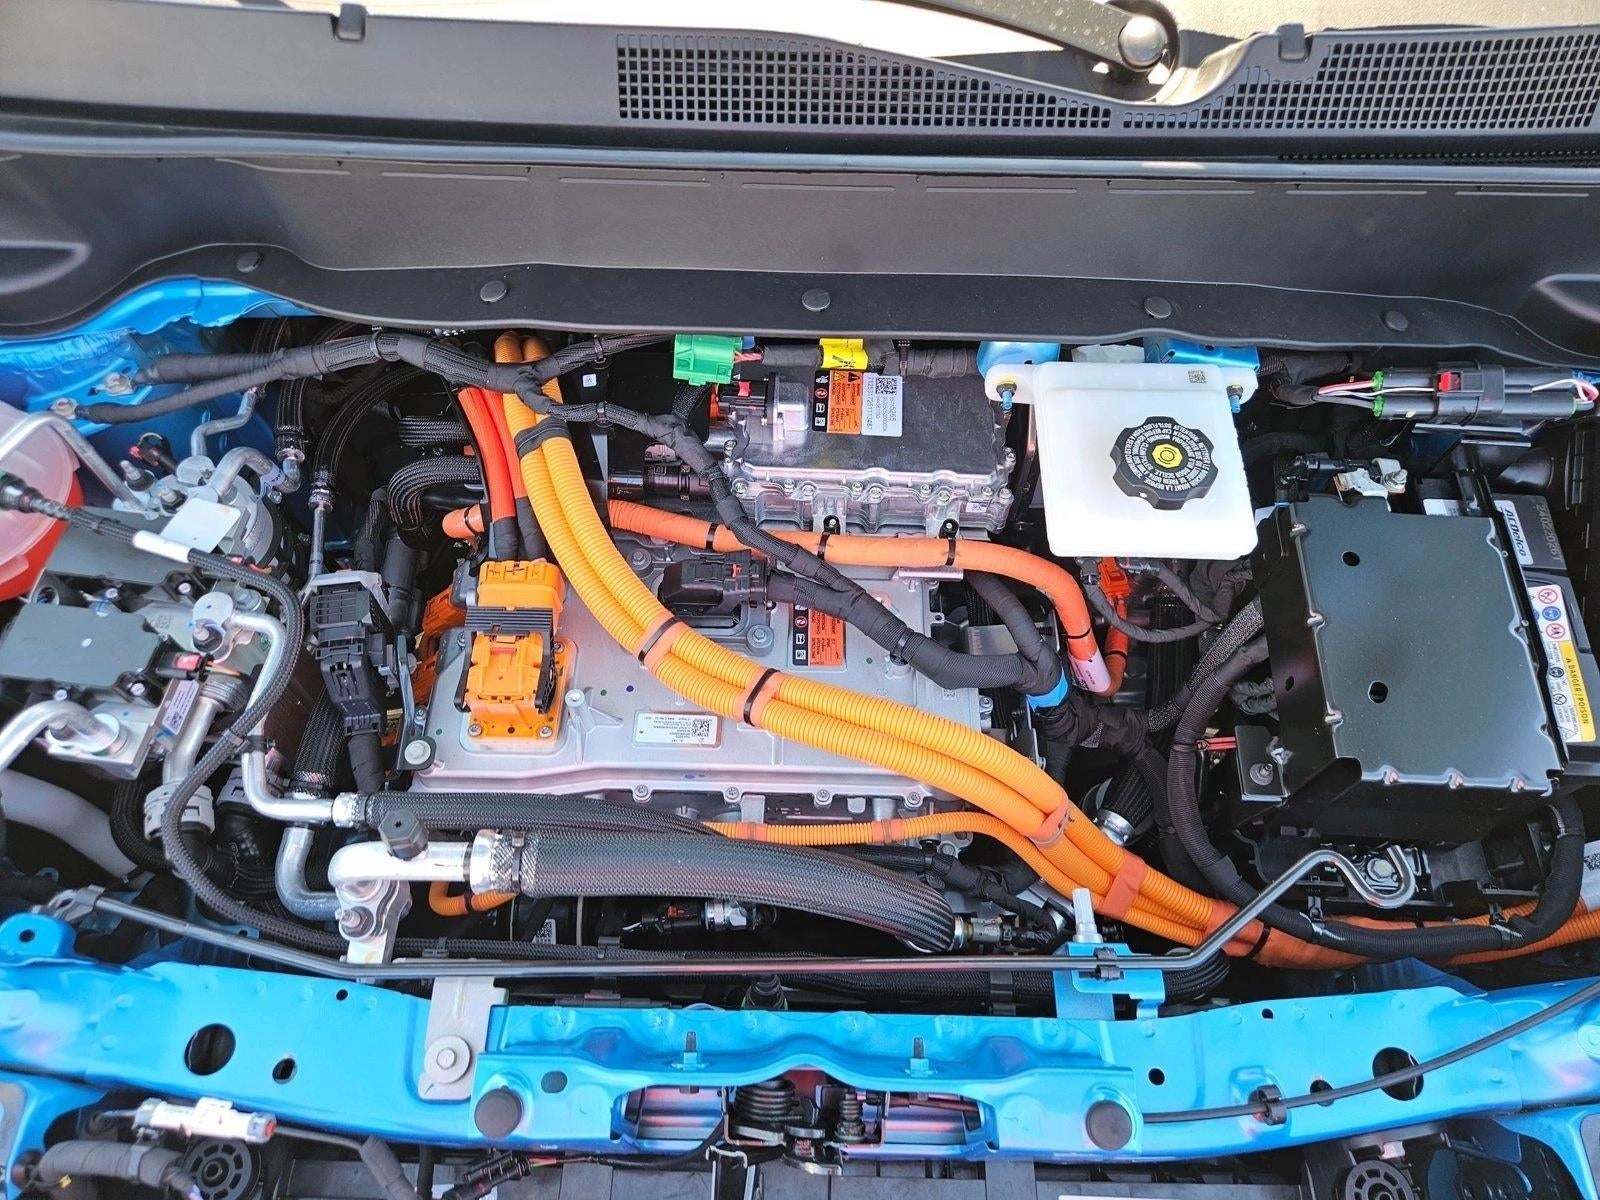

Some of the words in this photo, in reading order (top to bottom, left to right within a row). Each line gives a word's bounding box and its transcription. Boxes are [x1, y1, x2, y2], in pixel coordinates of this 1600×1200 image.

[1504, 508, 1527, 557] ACDelco
[1568, 664, 1582, 693] DANGER
[1577, 697, 1589, 724] POISON
